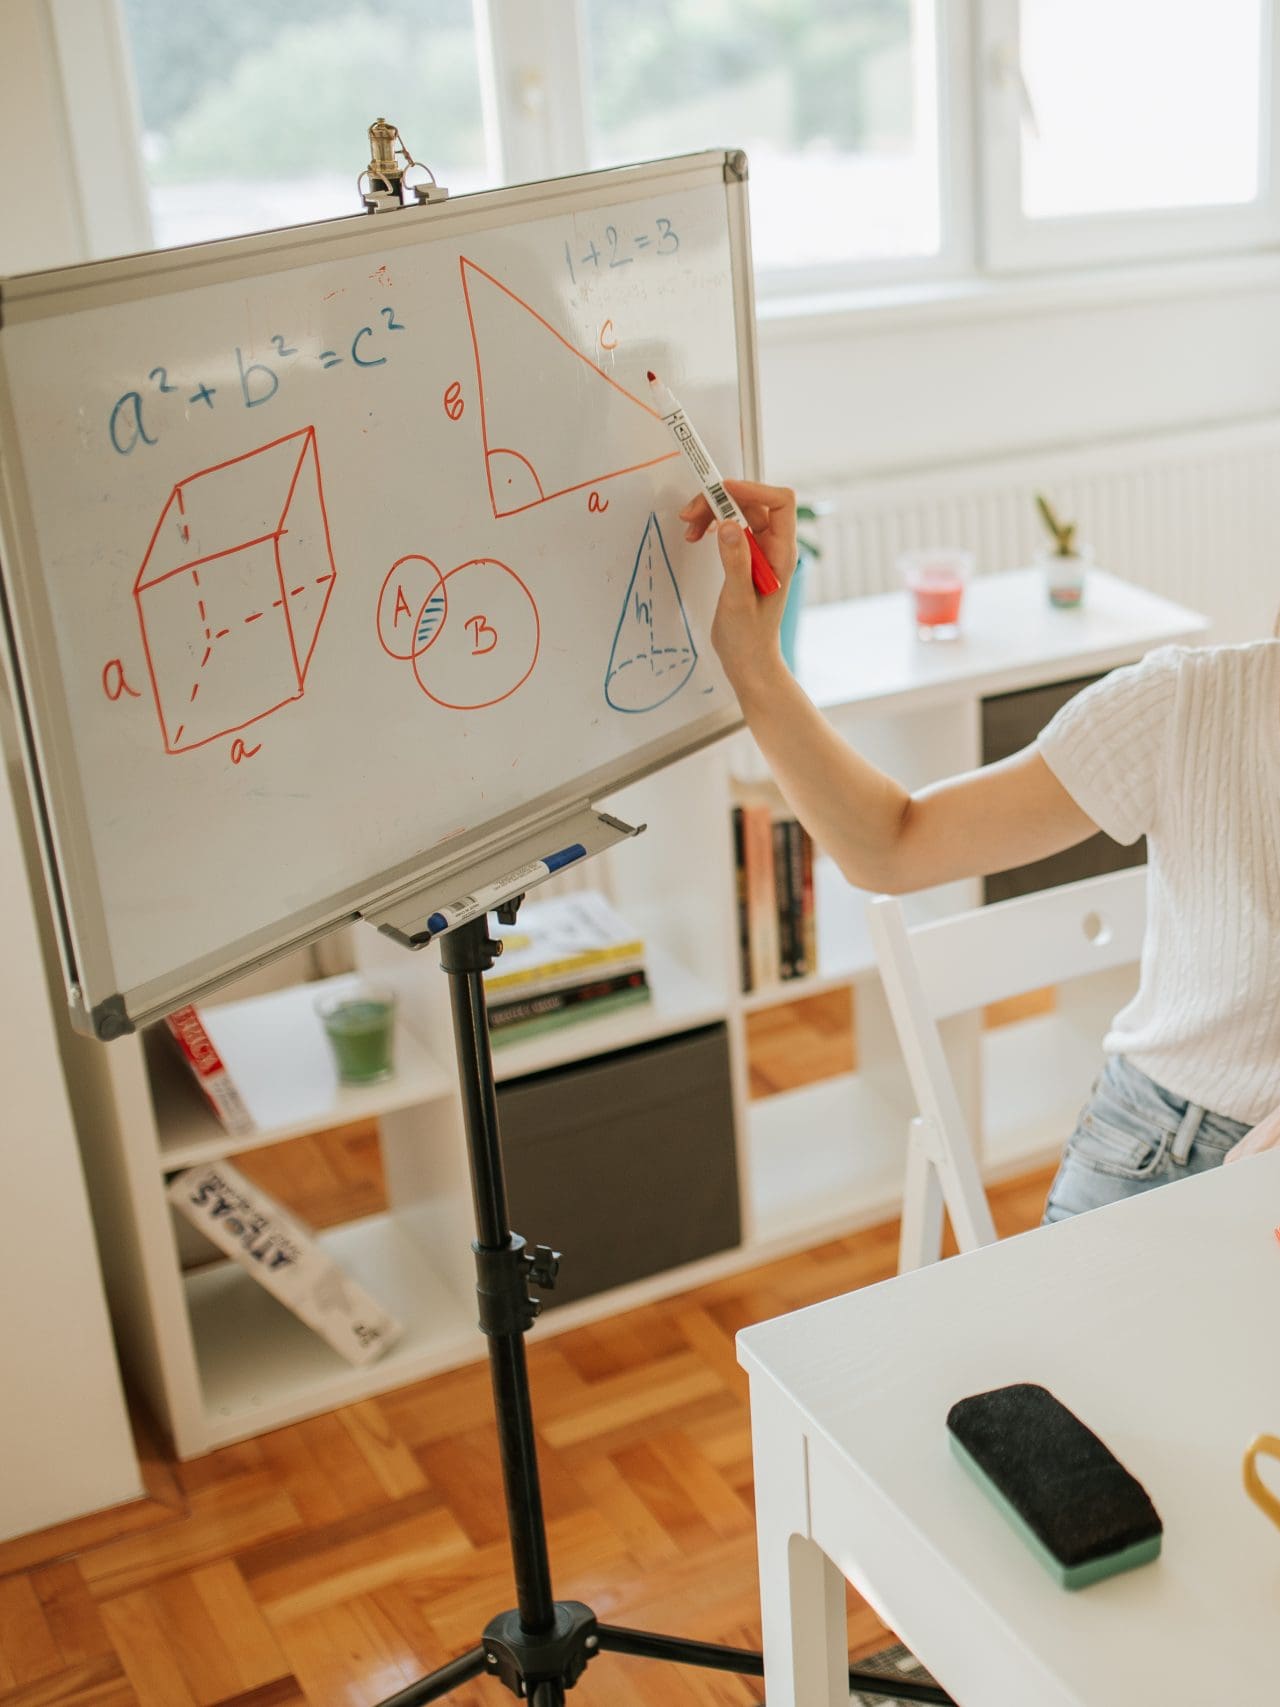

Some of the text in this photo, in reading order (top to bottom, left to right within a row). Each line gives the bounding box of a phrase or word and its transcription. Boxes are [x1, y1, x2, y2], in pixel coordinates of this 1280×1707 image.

[587, 491, 609, 513] a
[393, 584, 412, 629] A
[635, 591, 650, 625] h
[463, 614, 499, 656] B
[102, 658, 142, 702] a
[230, 738, 263, 765] a
